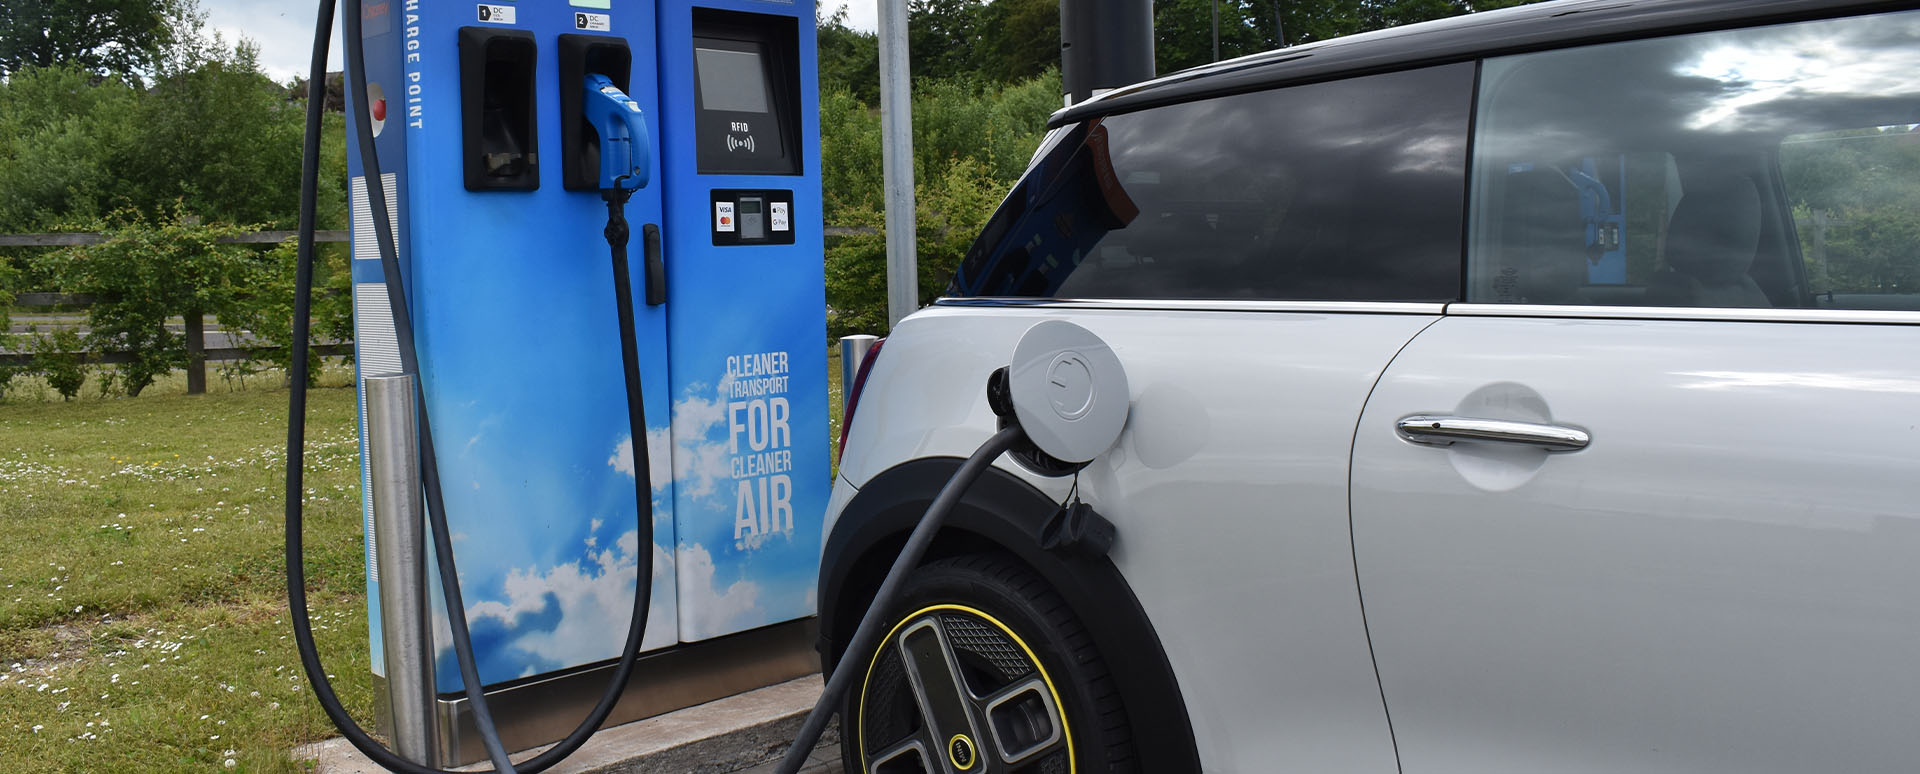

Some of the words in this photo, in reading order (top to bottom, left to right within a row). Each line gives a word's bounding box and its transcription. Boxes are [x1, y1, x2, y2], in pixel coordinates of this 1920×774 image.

[481, 9, 487, 17] 1
[578, 16, 584, 25] 2
[408, 71, 422, 129] POINT
[731, 121, 748, 132] RFID
[727, 351, 789, 378] CLEANER
[728, 375, 789, 399] TRANSPORT
[728, 397, 791, 454] FOR
[731, 450, 792, 479] CLEANER
[734, 473, 794, 540] AIR
[955, 741, 967, 762] MINI
